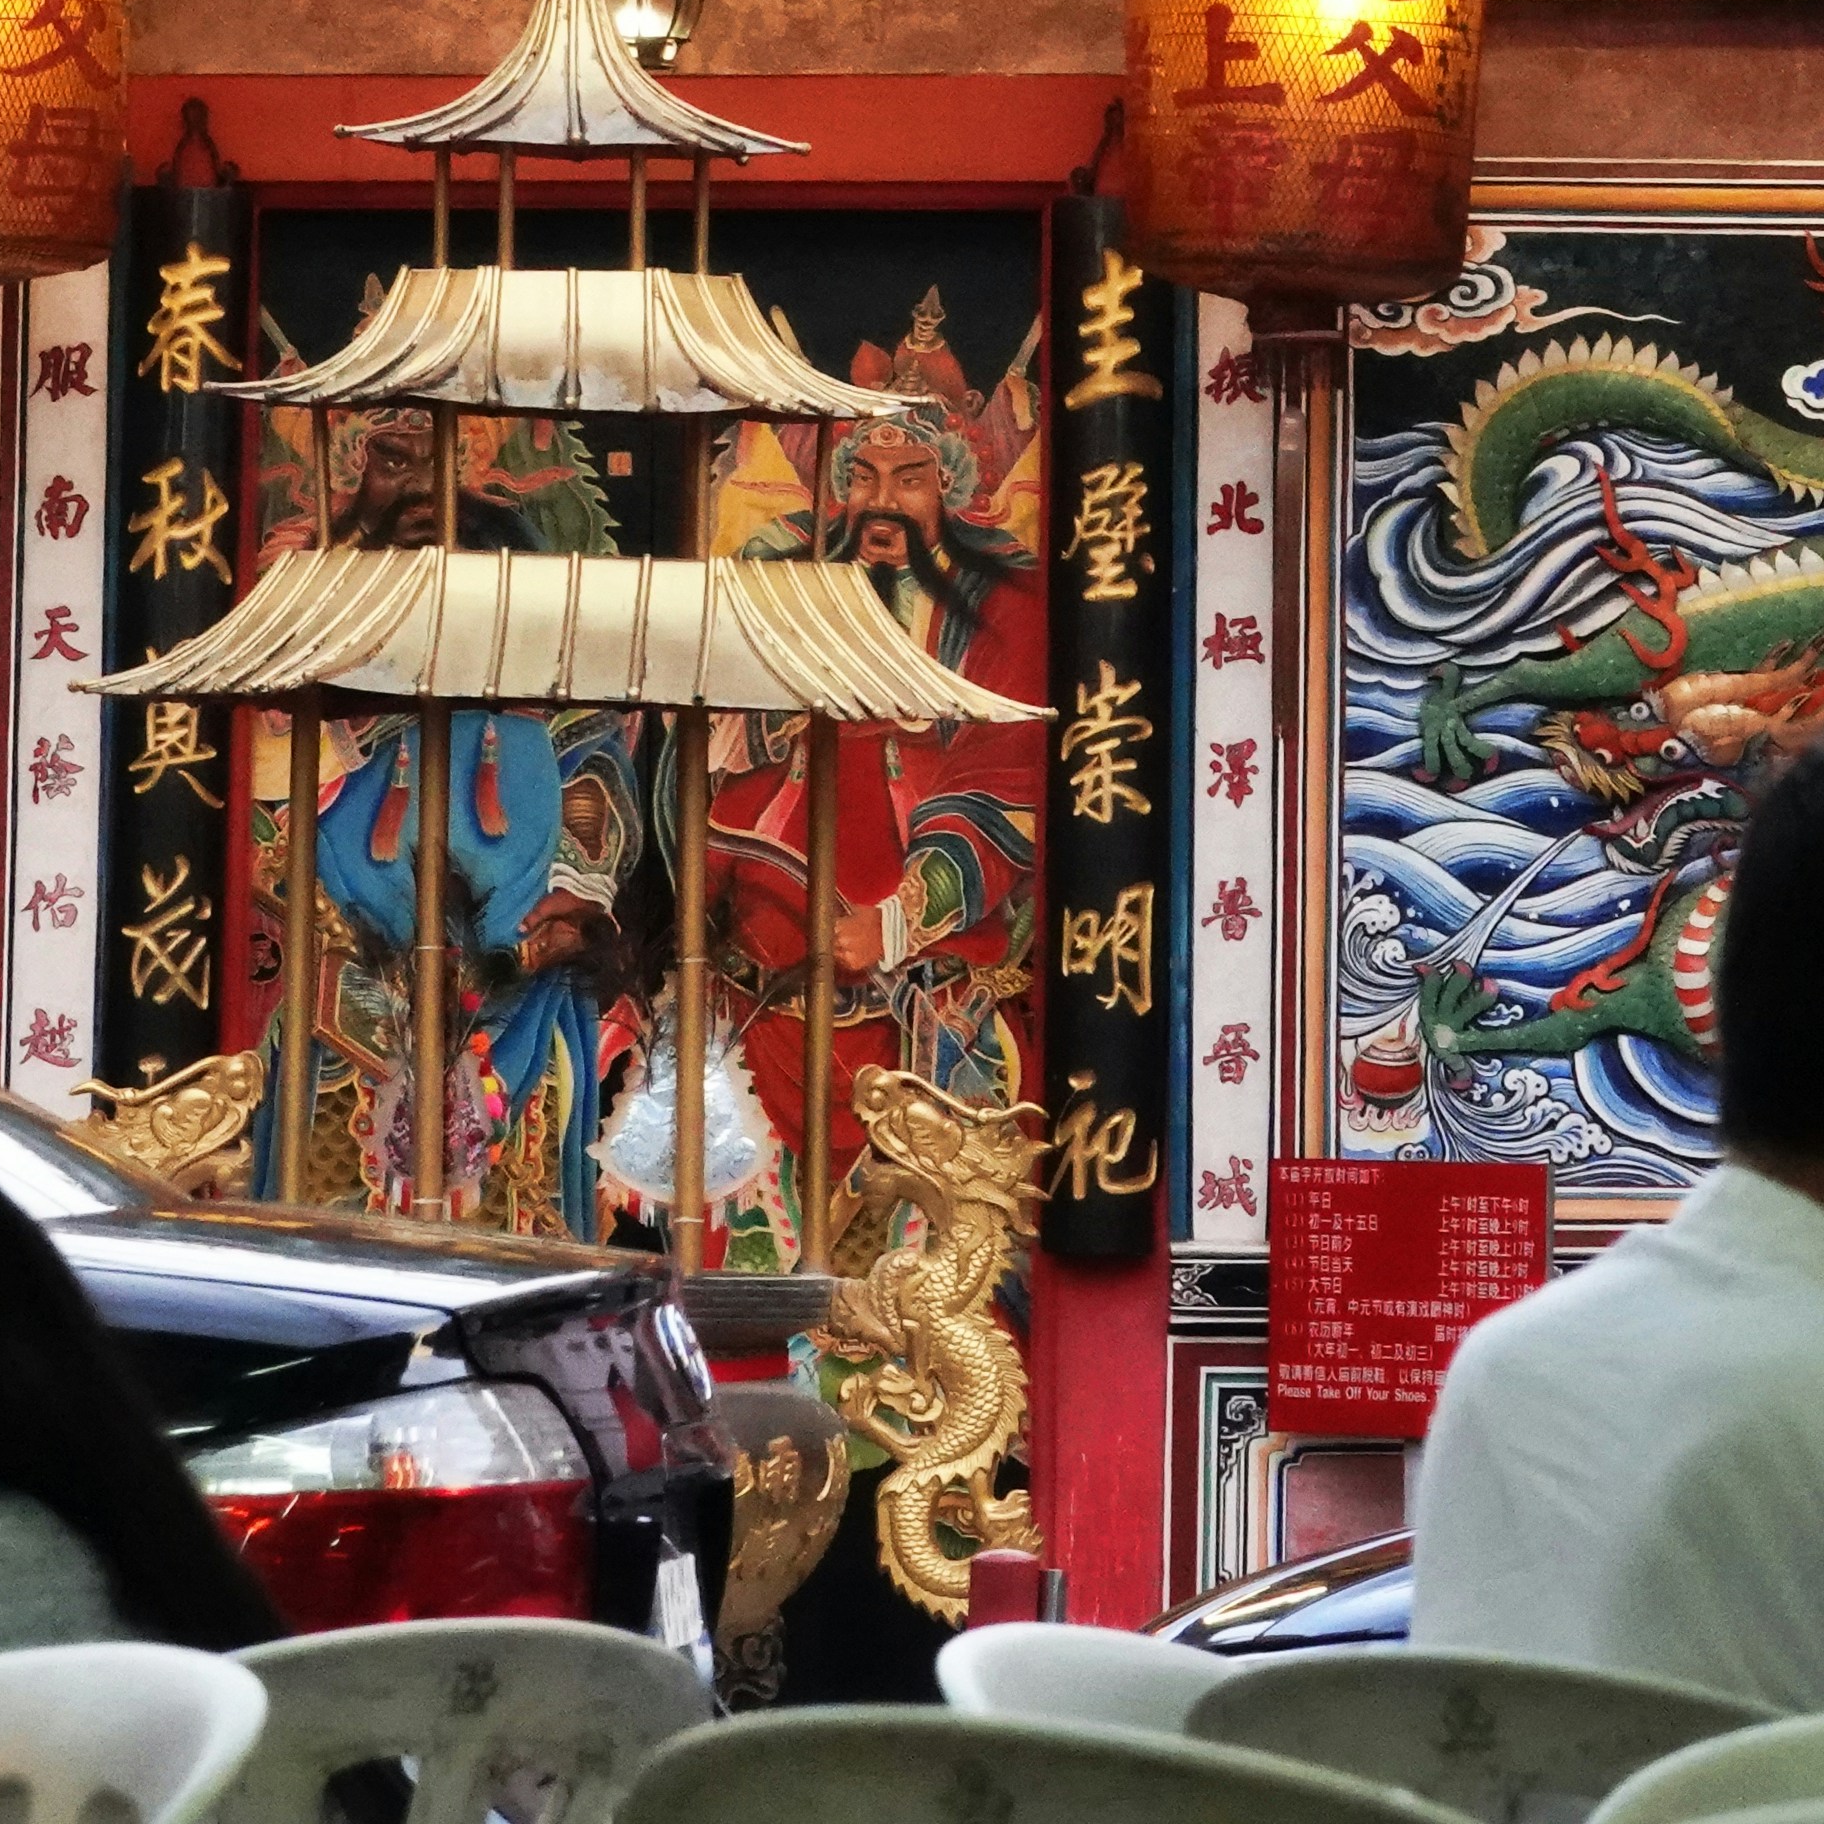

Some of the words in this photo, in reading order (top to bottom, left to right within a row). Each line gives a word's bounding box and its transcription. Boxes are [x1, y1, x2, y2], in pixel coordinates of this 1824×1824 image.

[1277, 1383, 1312, 1399] Please
[1317, 1384, 1341, 1400] Take
[1345, 1386, 1363, 1401] Off
[1366, 1386, 1390, 1402] Your
